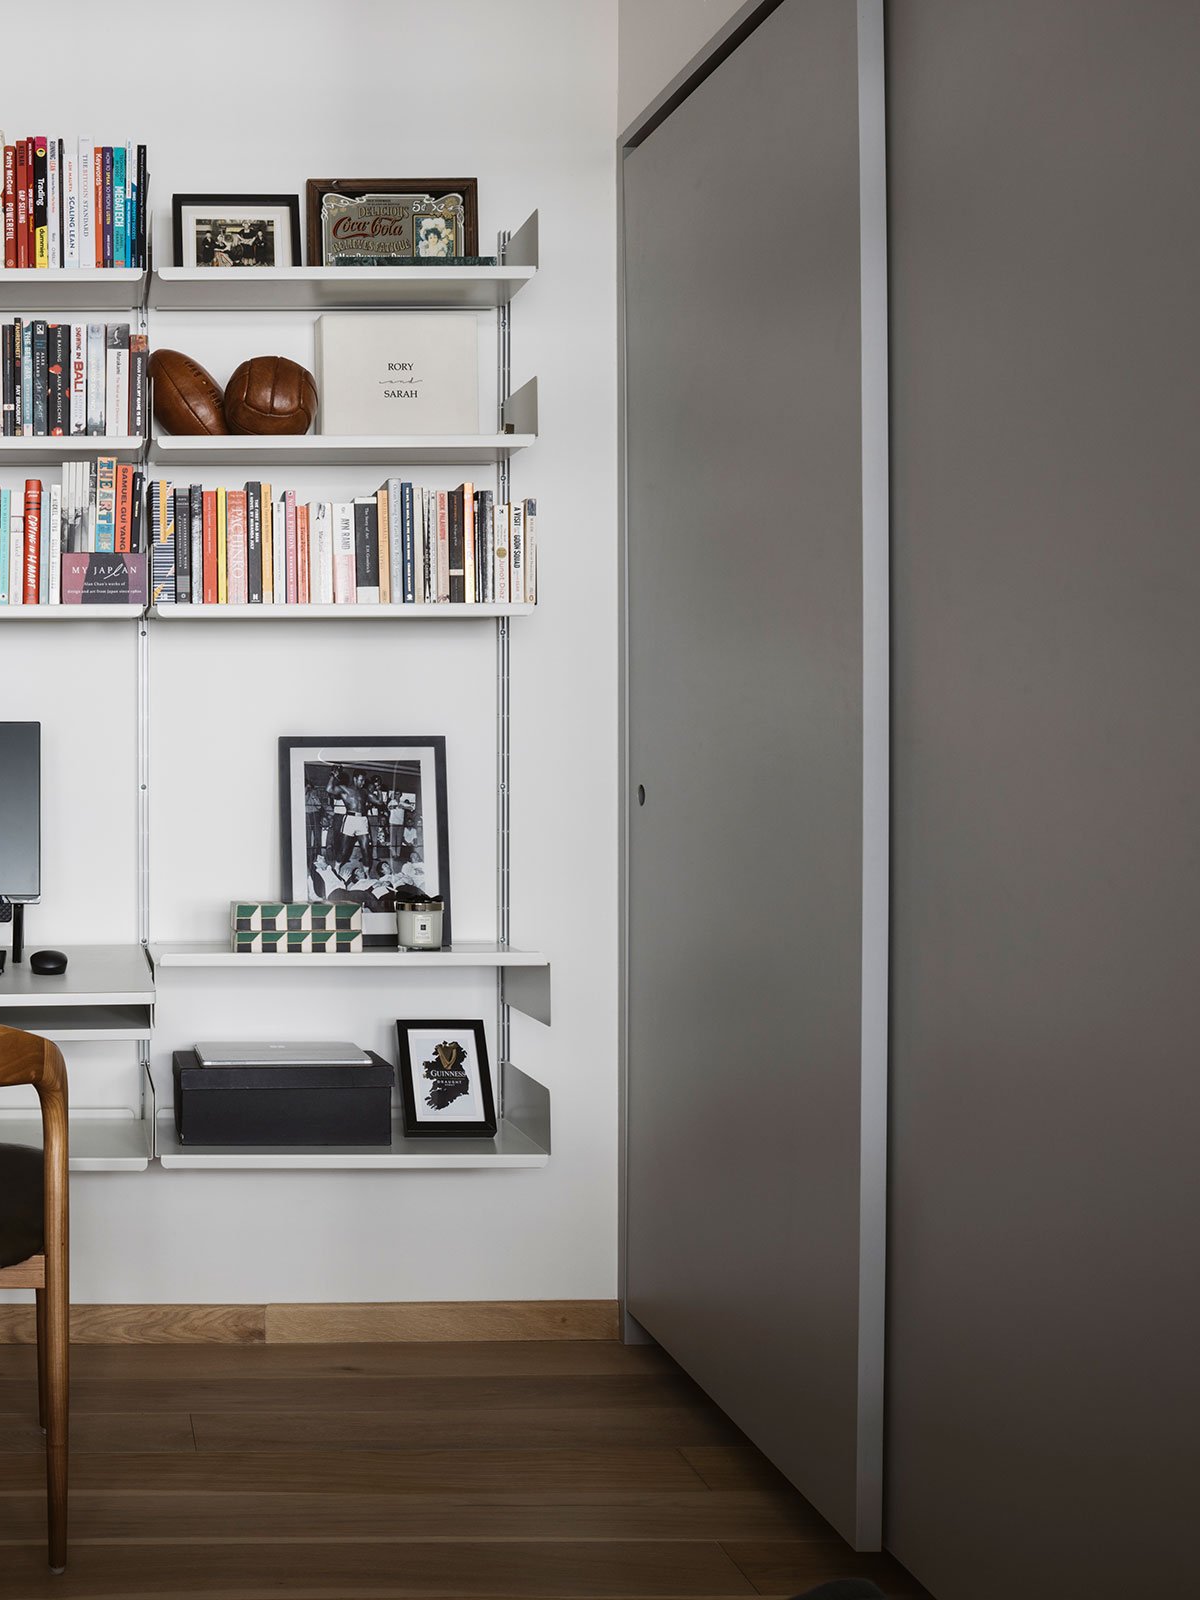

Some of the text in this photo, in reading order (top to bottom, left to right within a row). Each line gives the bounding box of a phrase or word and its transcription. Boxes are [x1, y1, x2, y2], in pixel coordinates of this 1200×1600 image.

[36, 178, 44, 206] Trading
[115, 186, 124, 227] MEGATECH
[357, 206, 410, 219] DELICIOUS
[332, 239, 412, 253] RELIEVES FATIGUE
[74, 361, 84, 393] BALI
[388, 362, 414, 371] RORY
[383, 390, 418, 398] SARAH
[98, 461, 113, 524] THE ART
[28, 515, 37, 543] CRYING
[340, 518, 349, 550] AYN RAND
[231, 509, 243, 578] PACHINKO
[28, 554, 36, 562] H
[72, 566, 88, 574] MY
[27, 564, 35, 589] MART
[430, 1069, 466, 1078] GUINNESS
